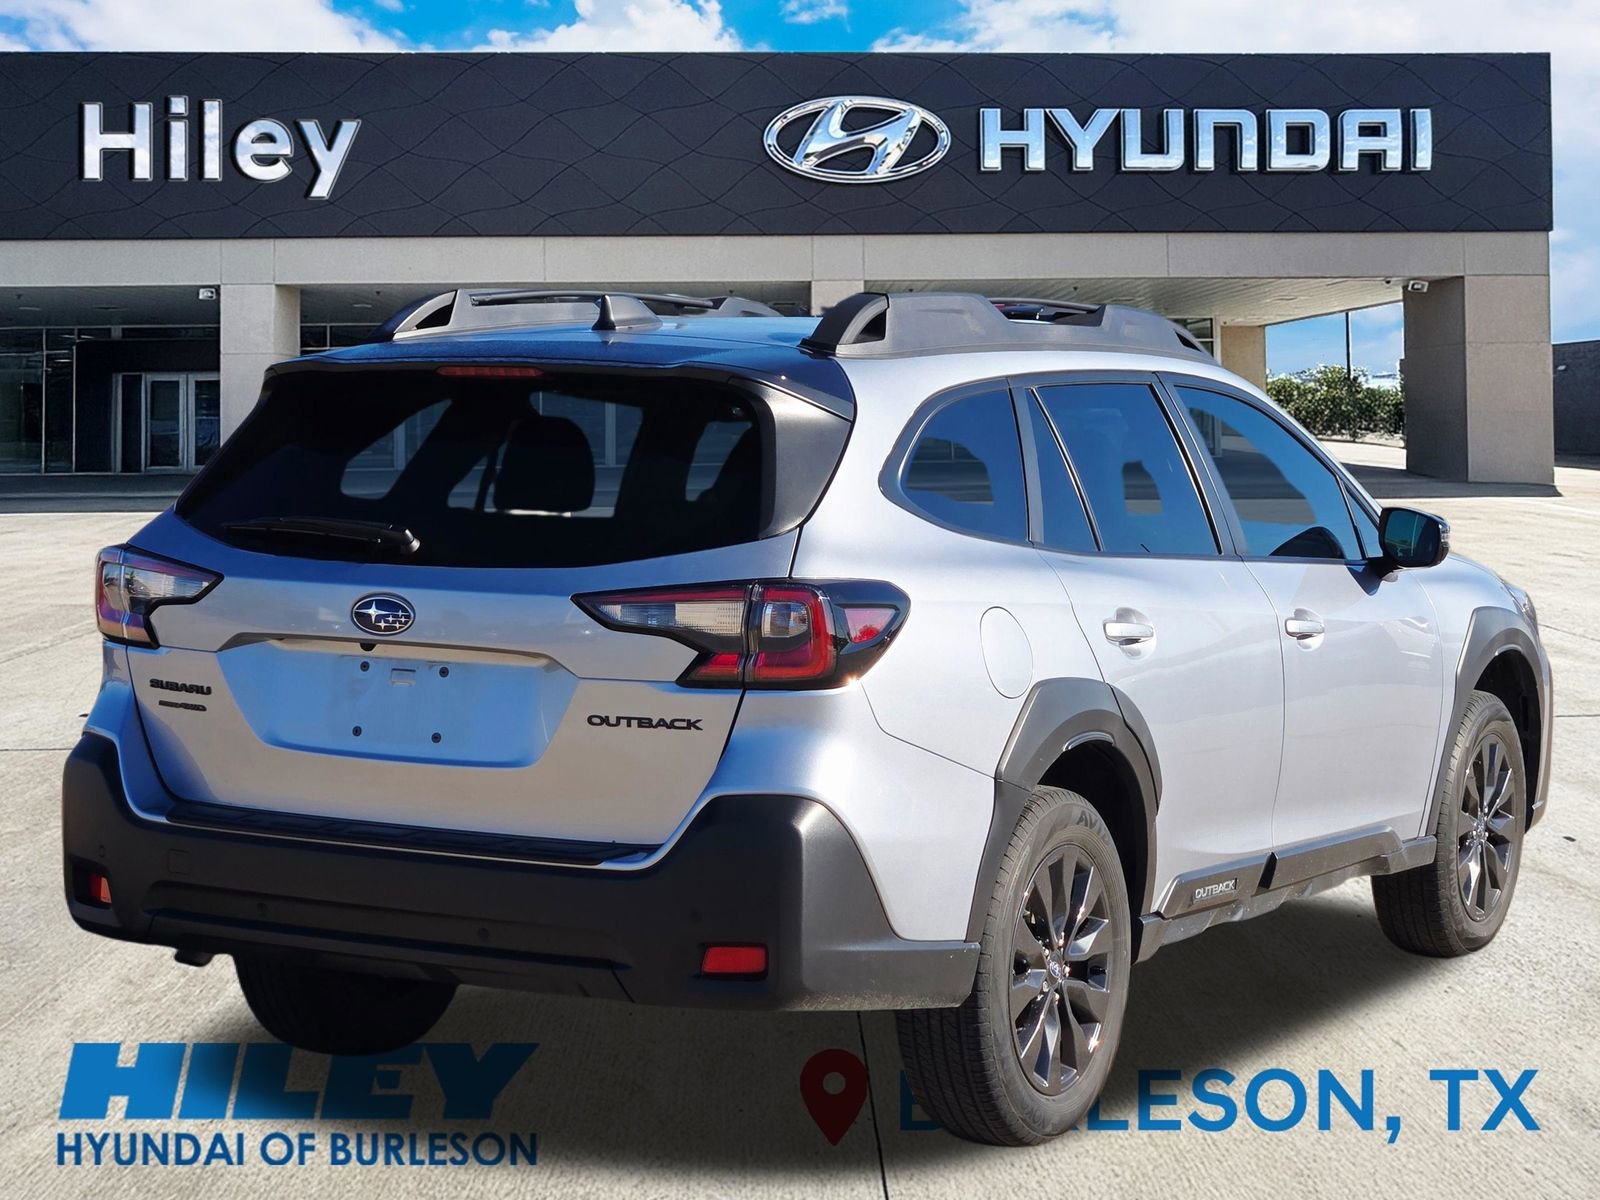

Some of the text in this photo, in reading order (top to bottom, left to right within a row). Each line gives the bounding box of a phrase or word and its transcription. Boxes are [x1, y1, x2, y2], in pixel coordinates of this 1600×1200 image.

[79, 95, 361, 199] Hiley
[979, 107, 1433, 173] HYUNDAI
[149, 678, 212, 695] SUBARU
[587, 714, 703, 731] OUTBACK
[1194, 879, 1236, 899] OUTBACK
